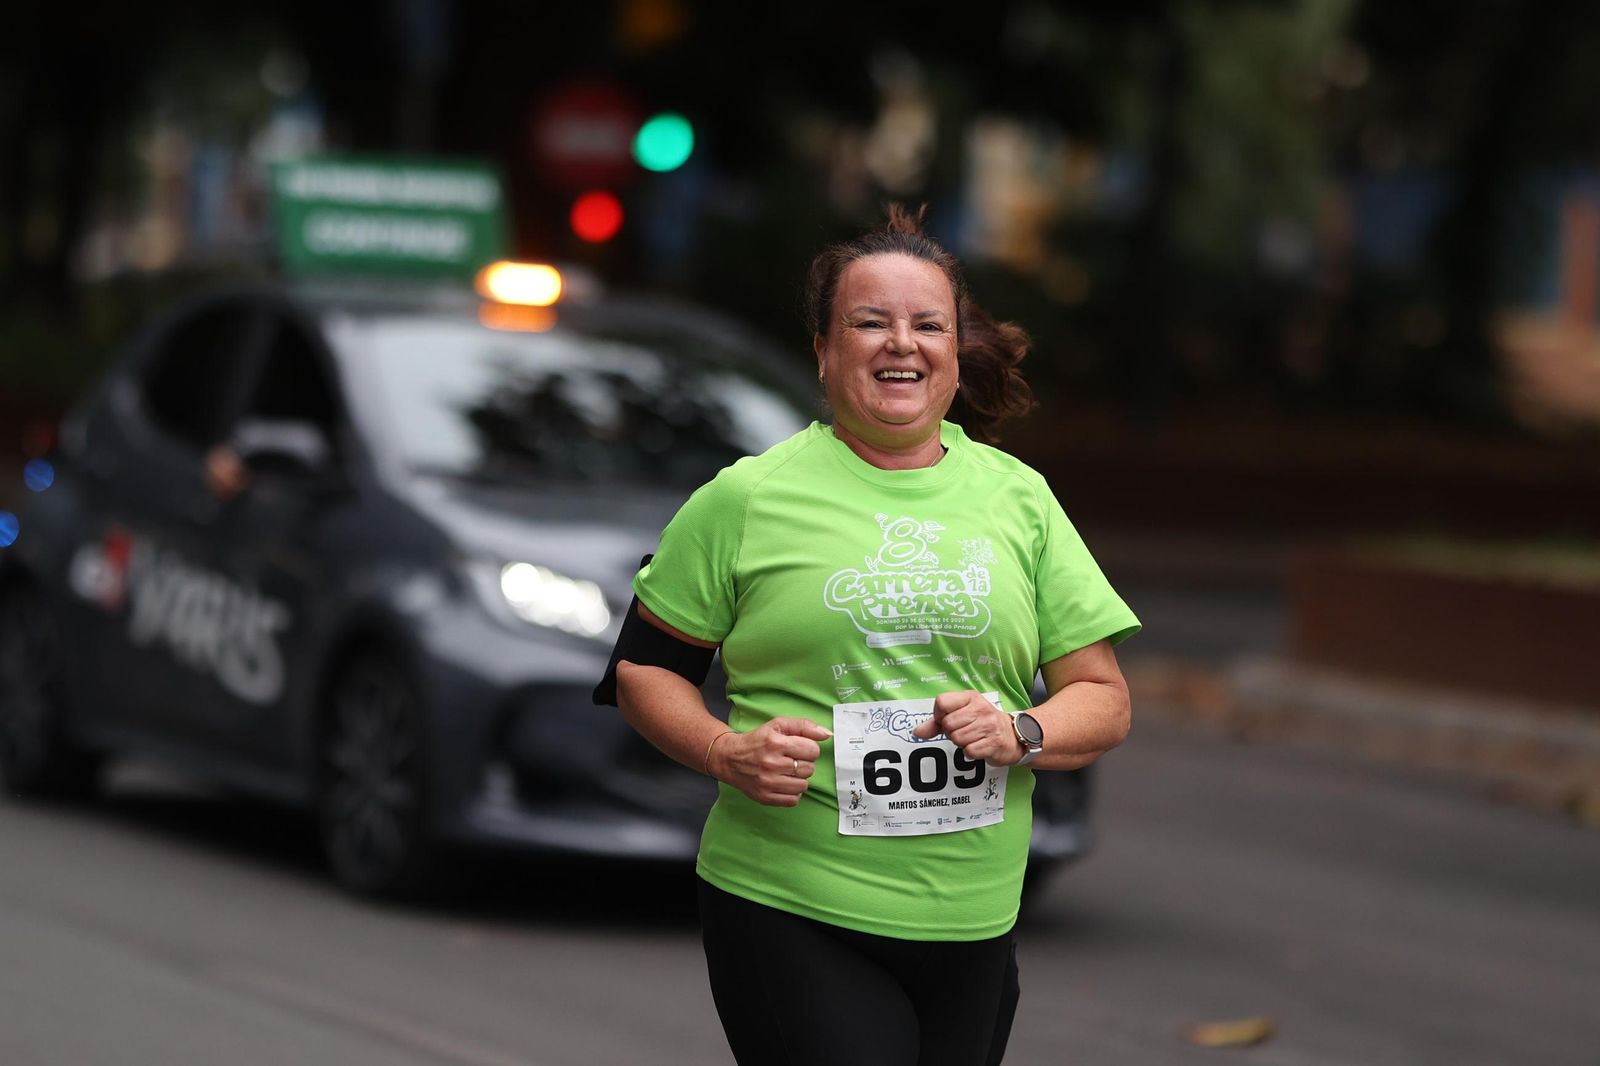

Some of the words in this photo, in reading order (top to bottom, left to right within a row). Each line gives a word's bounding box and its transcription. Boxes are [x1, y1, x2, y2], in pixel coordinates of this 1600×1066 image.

[829, 571, 966, 604] Carrera
[860, 593, 978, 620] Prensa
[863, 747, 986, 796] 609
[888, 801, 918, 810] MARTOS
[919, 797, 950, 809] SÁNCHEZ,
[951, 795, 971, 805] ISABEL
